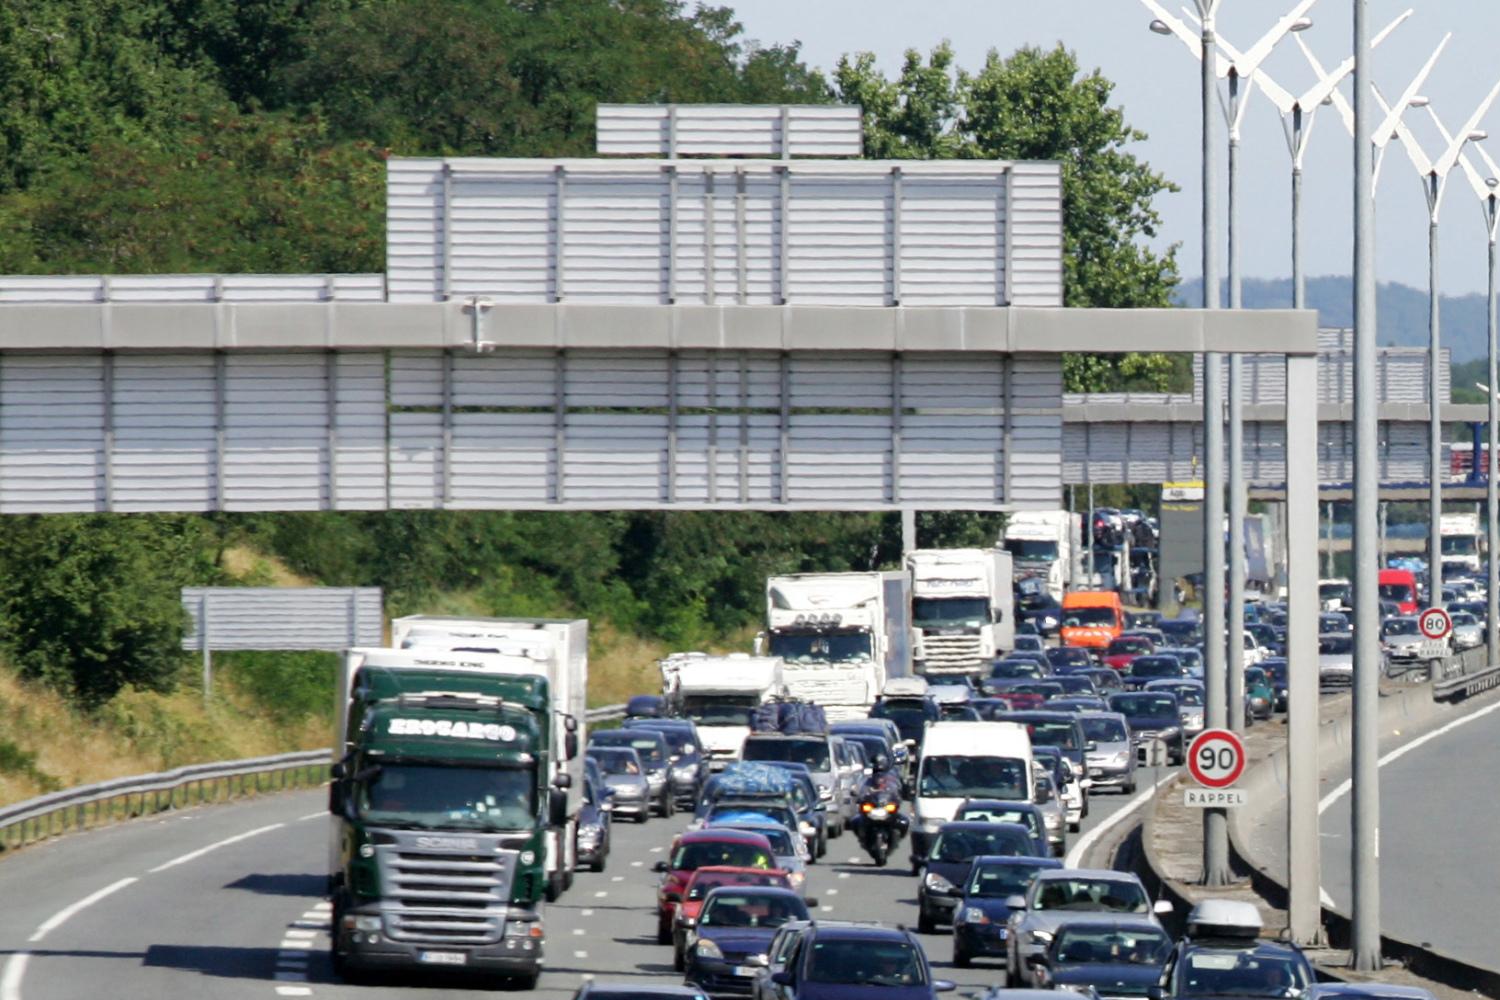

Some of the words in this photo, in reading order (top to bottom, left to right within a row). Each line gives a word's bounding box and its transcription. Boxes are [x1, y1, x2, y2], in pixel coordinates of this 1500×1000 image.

[1425, 617, 1444, 630] 80
[1200, 746, 1235, 770] 90
[1189, 792, 1243, 803] RAPPEL
